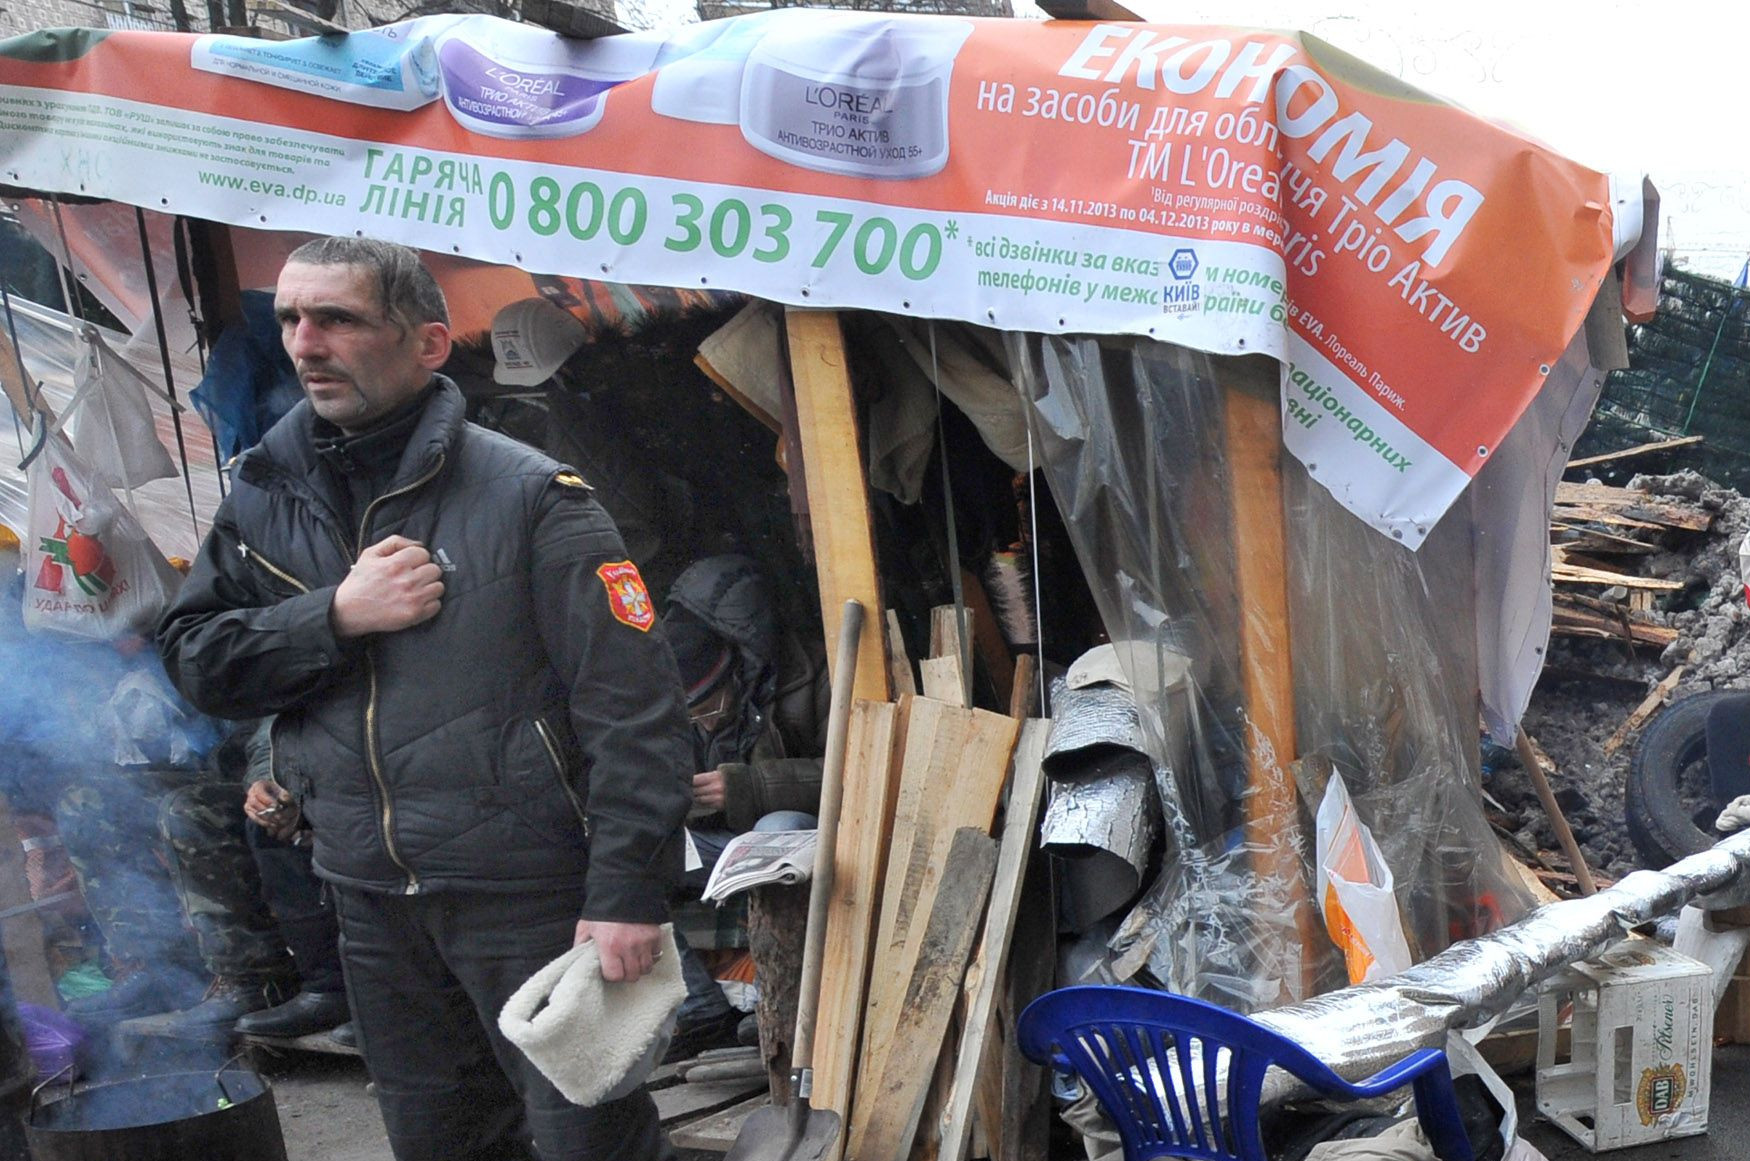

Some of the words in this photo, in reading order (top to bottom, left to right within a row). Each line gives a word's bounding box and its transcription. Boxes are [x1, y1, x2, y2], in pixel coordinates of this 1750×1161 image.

[811, 120, 846, 139] ТРИО
[849, 126, 890, 143] АКТИВ
[1059, 24, 1485, 268] ЕКОНОМІЯ
[363, 147, 484, 196] ГАРЯЧА
[977, 80, 1014, 114] на
[1023, 86, 1140, 132] засоби
[1144, 102, 1203, 142] для
[1327, 195, 1392, 273] Тріо
[1127, 139, 1171, 182] ТМ
[199, 170, 346, 208] www.eva.dp.ua
[359, 183, 466, 228] ЛІНІЯ
[528, 175, 648, 247] 800
[663, 193, 793, 264] 303
[985, 190, 1017, 208] Акція
[1019, 194, 1039, 212] діє
[1051, 198, 1117, 218] 14.11.2013
[1119, 207, 1136, 221] по
[1138, 208, 1209, 231] 04.12.2013
[1211, 219, 1240, 236] року
[998, 236, 1077, 265] дзвінки
[1080, 250, 1107, 270] за
[977, 266, 1081, 297] телефонів
[1163, 281, 1200, 304] КИЇВ
[1658, 993, 1675, 1061] Pilsener
[1653, 1078, 1670, 1111] DAB
